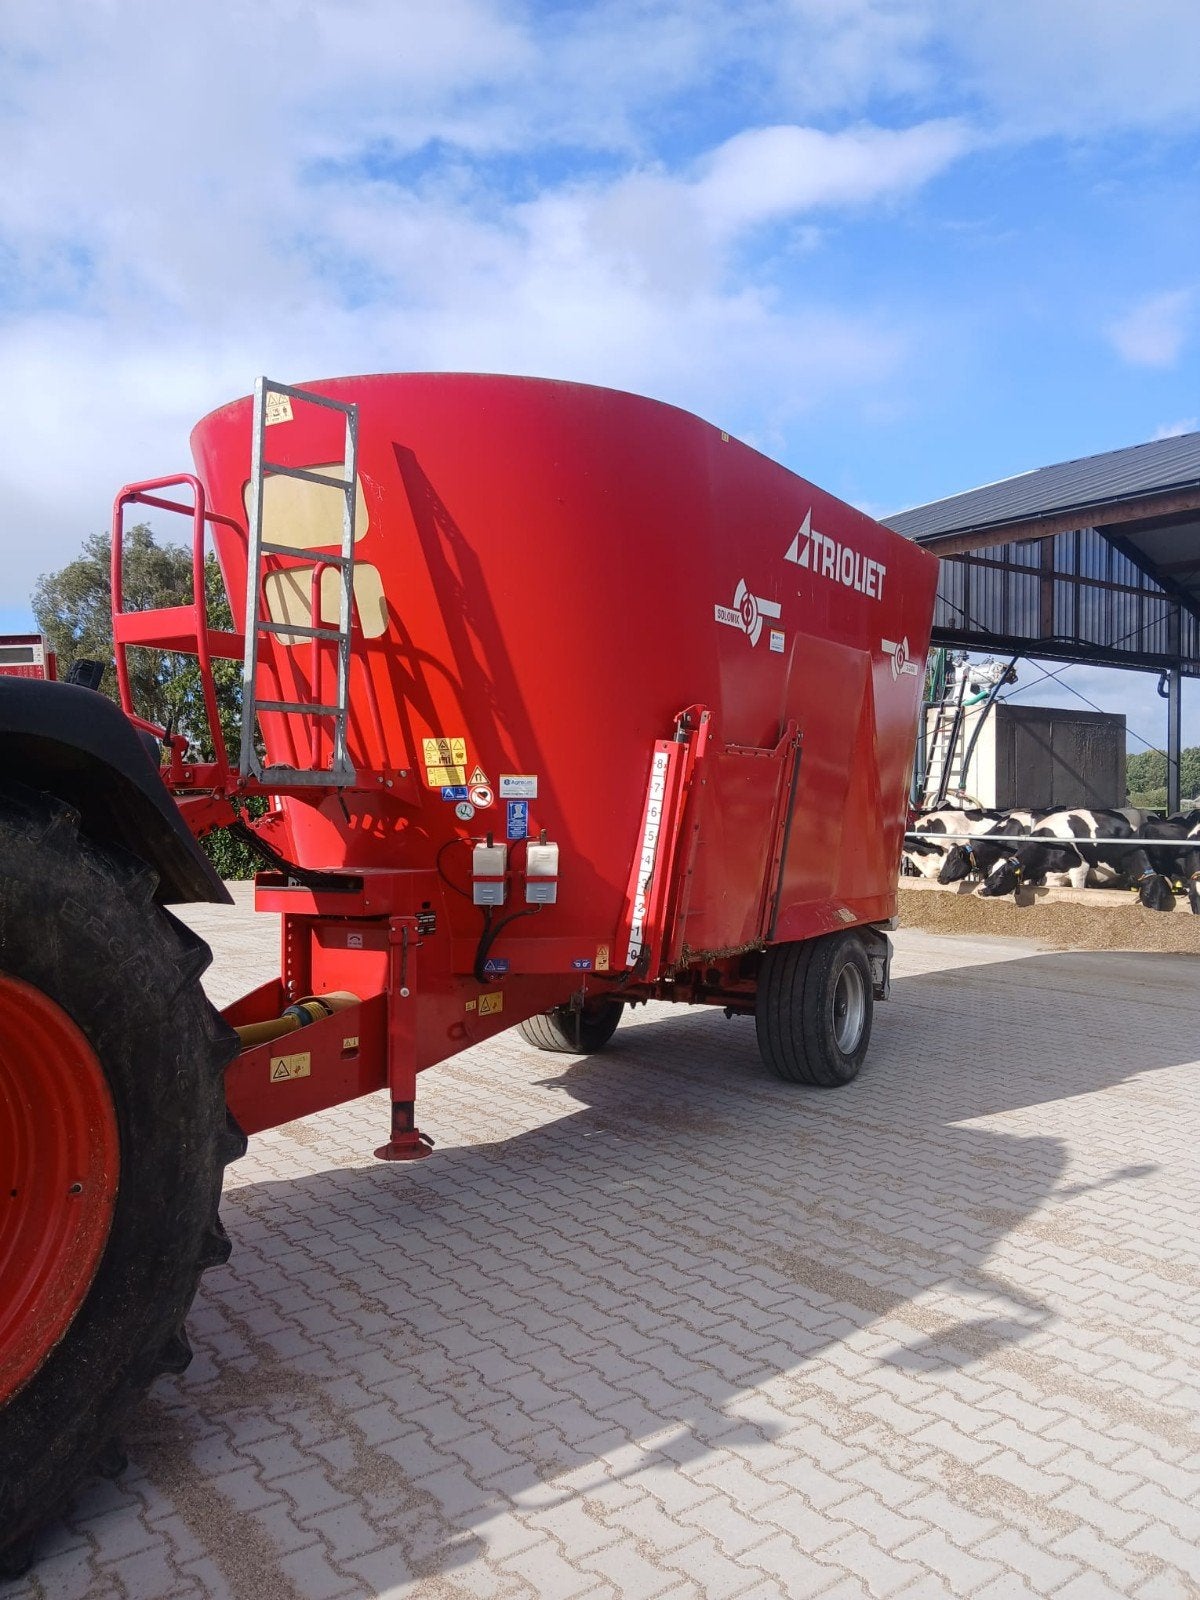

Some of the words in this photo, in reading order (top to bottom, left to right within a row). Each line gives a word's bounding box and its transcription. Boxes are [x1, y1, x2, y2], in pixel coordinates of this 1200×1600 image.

[811, 529, 886, 602] TRIOLIET
[717, 608, 740, 625] SOLOMIX
[656, 758, 663, 769] 8
[654, 782, 661, 793] 7
[650, 806, 657, 818] 6
[647, 830, 654, 841] 5
[644, 855, 651, 865] 4
[641, 878, 647, 889] 3
[637, 902, 644, 913] 2
[635, 925, 640, 937] 1
[630, 949, 637, 960] 0
